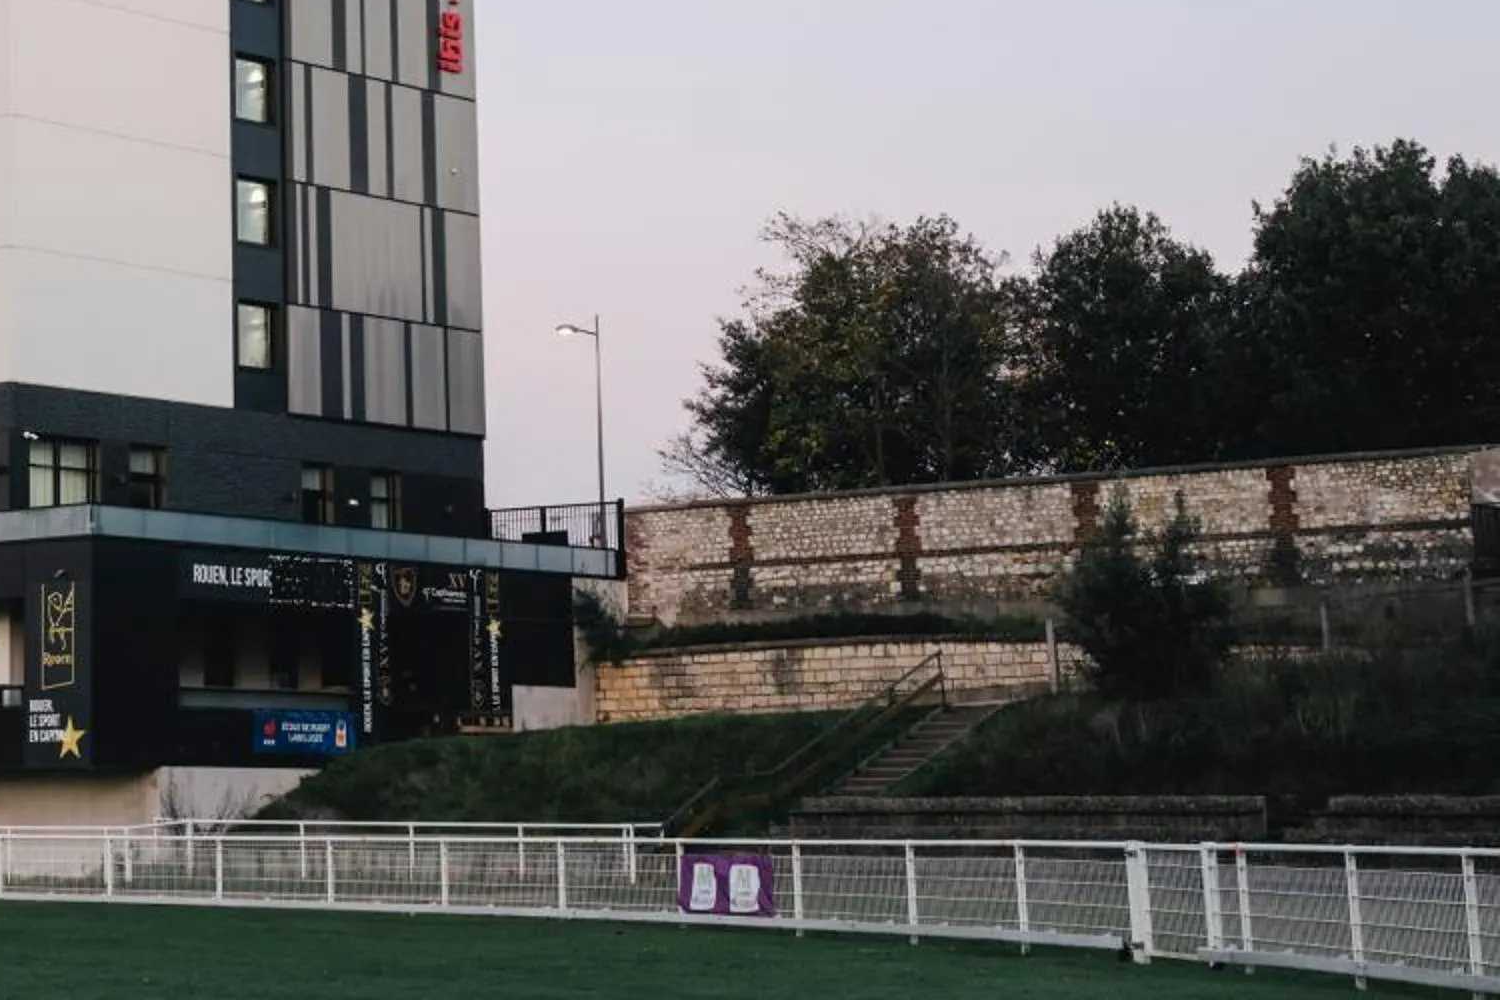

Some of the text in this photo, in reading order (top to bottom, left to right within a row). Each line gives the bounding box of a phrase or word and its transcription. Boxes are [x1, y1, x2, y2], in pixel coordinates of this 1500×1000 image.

[436, 11, 463, 73] ibis
[193, 563, 273, 588] ROUEN, LE SPOR
[29, 714, 38, 728] LE
[29, 729, 39, 743] EN
